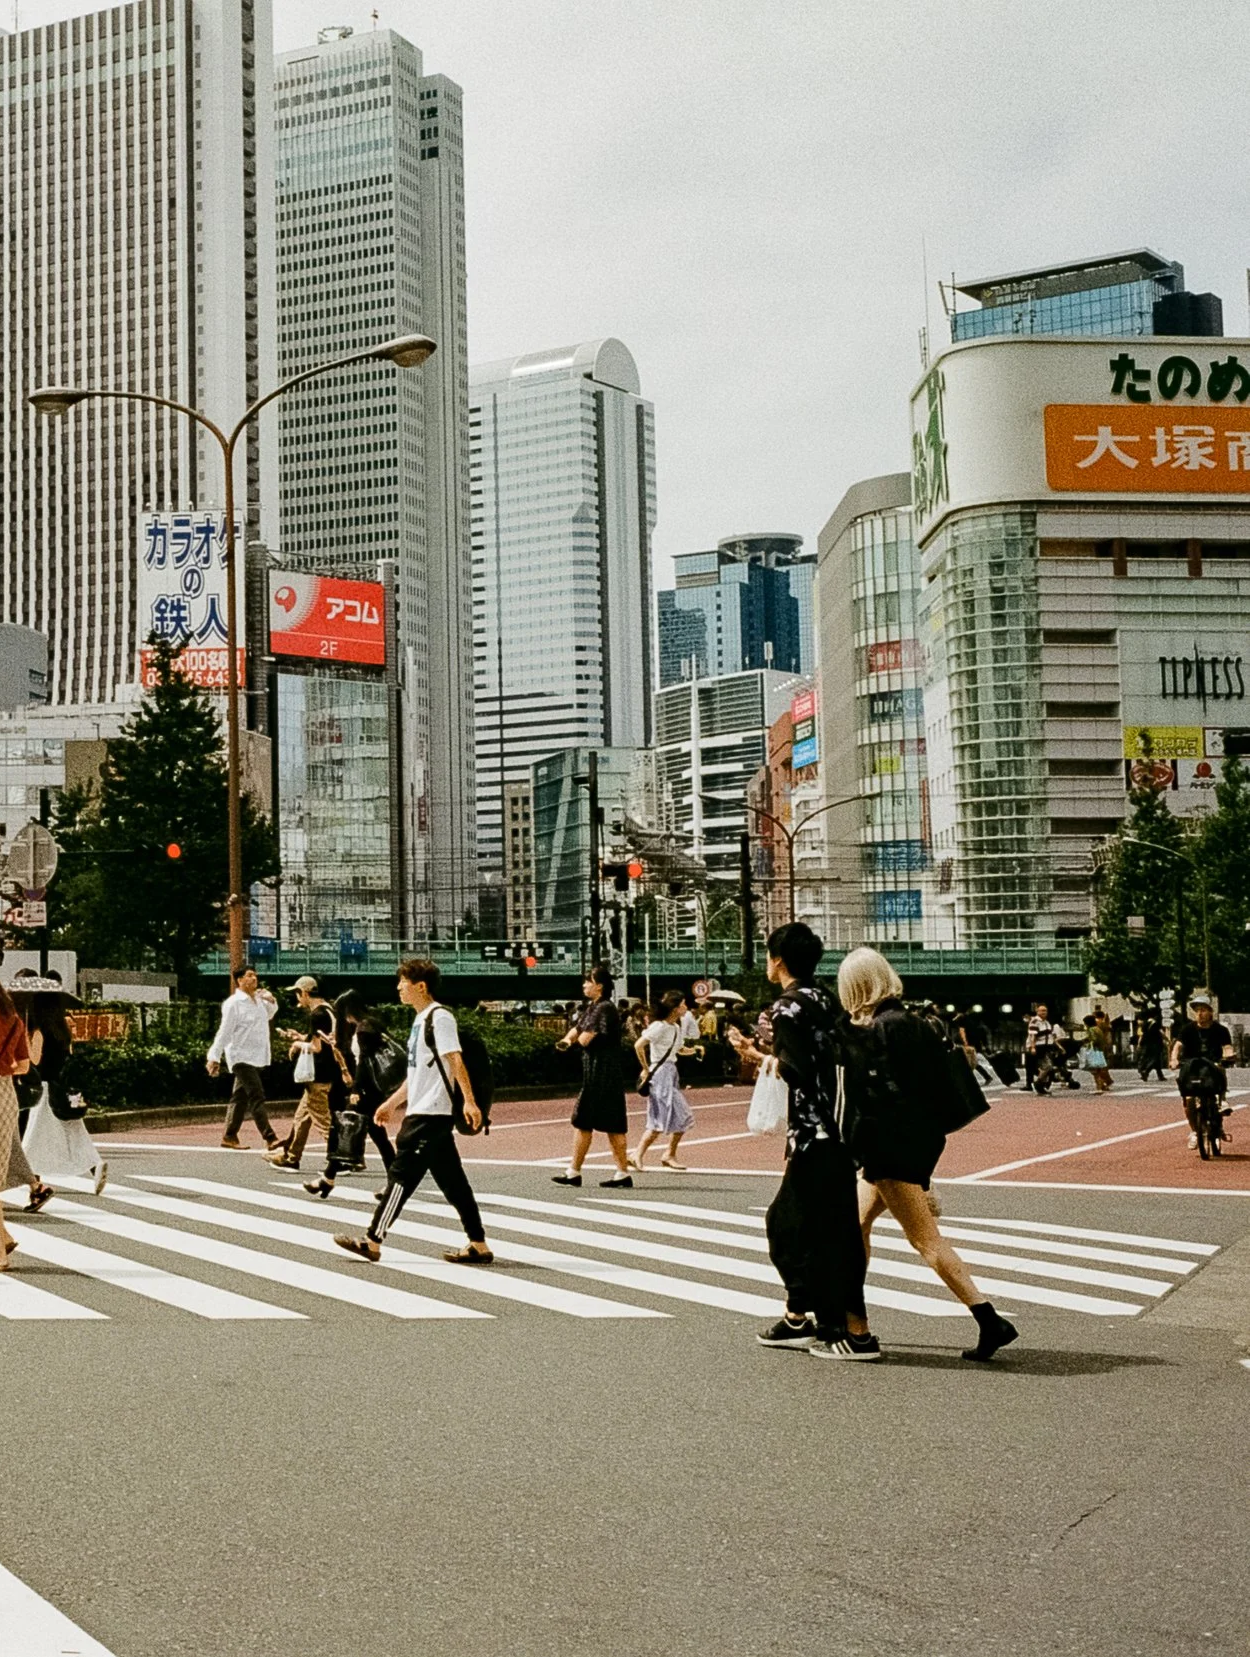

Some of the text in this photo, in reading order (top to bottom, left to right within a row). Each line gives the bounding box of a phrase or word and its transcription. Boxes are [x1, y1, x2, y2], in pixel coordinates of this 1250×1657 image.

[144, 514, 242, 568] カラオケ
[181, 569, 203, 596] の
[153, 597, 229, 641] 鉄人
[326, 596, 380, 625] アコム
[320, 640, 338, 655] 2F
[1159, 645, 1245, 708] TIPNESS
